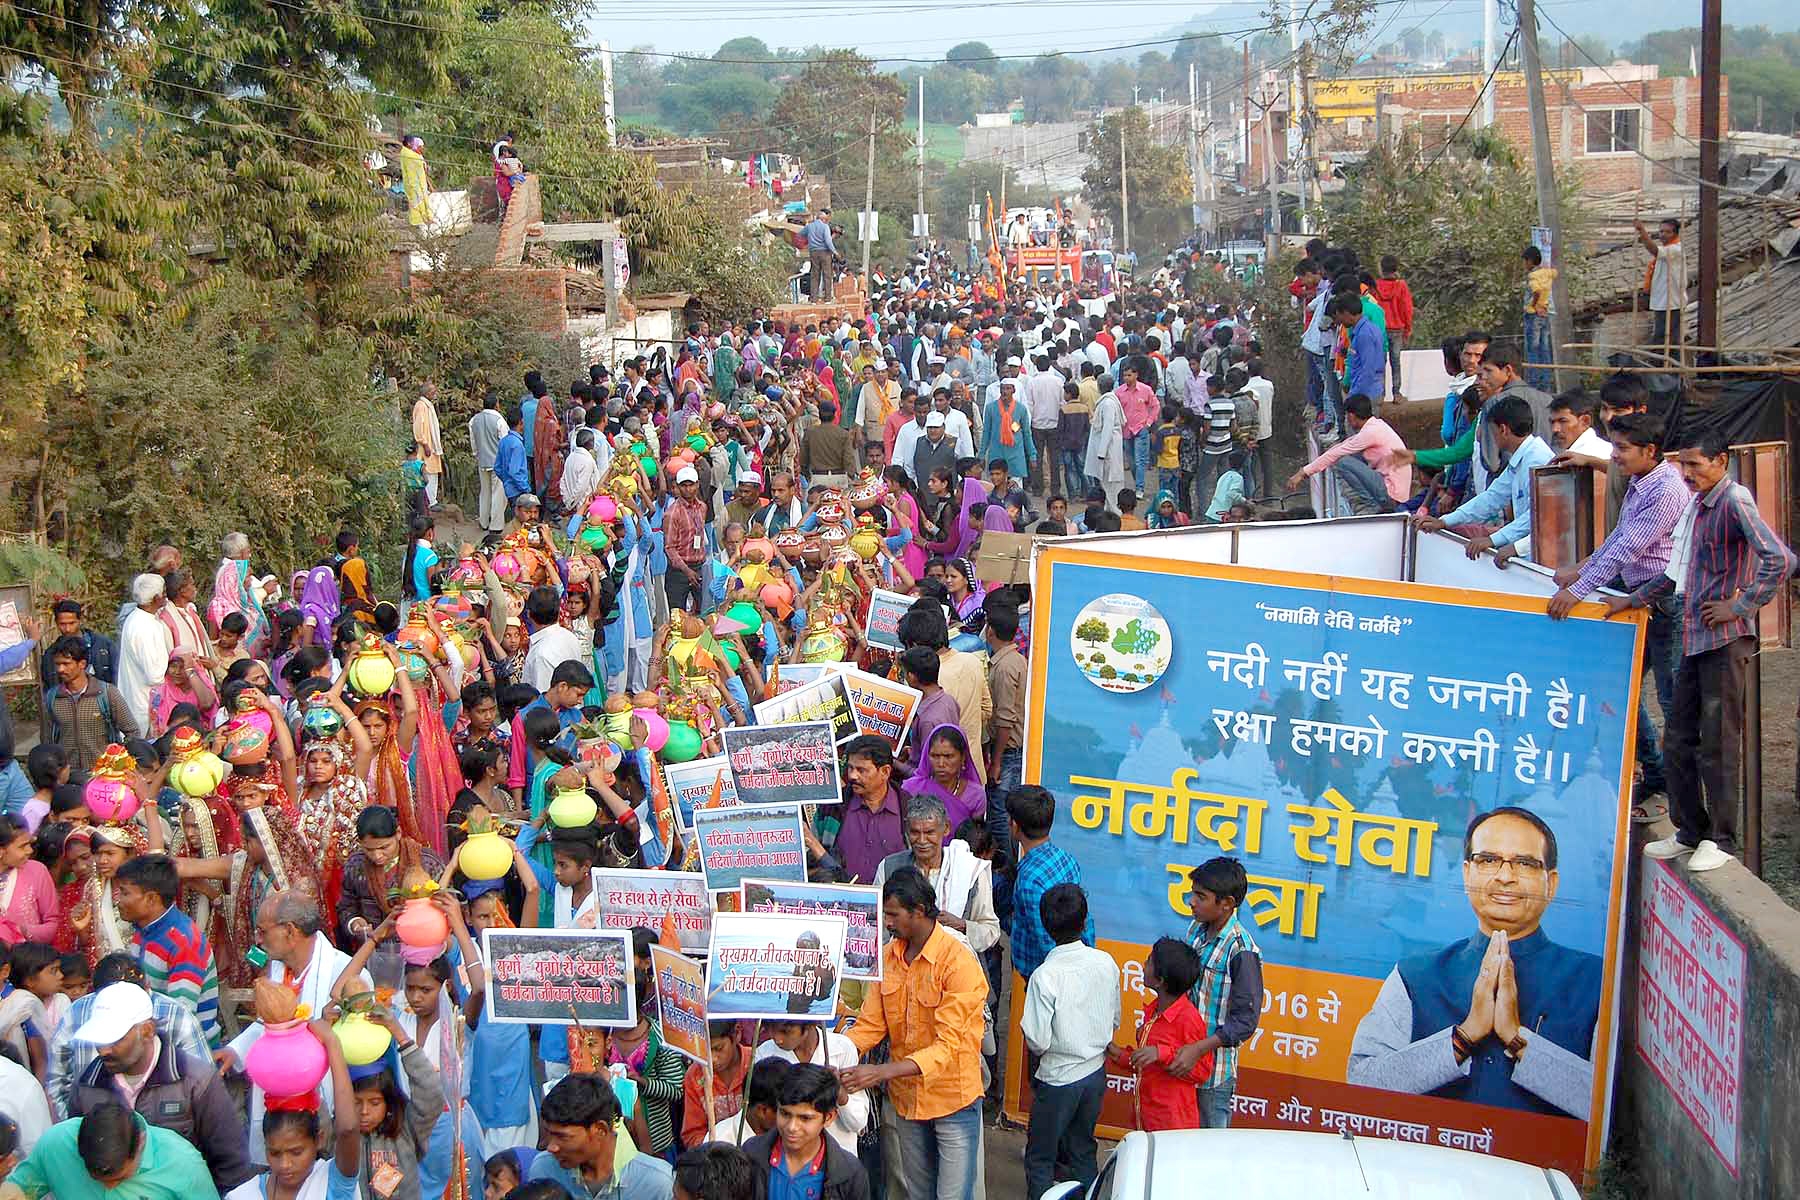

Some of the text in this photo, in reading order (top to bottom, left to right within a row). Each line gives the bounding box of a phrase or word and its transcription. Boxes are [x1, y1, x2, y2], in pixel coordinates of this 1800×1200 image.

[1324, 609, 1354, 630] देवि
[1206, 642, 1270, 688] नदी
[1283, 651, 1348, 700] नहीं
[1360, 668, 1414, 709] यह
[1427, 671, 1532, 718] जननी
[1212, 708, 1277, 745] रक्षा
[1290, 714, 1388, 758] हमको
[1402, 728, 1500, 773] करनी
[732, 745, 752, 772] युगों
[783, 742, 794, 763] से
[795, 741, 817, 763] देखा
[739, 769, 765, 789] नर्मदा
[765, 767, 794, 788] जीवन
[794, 765, 816, 785] रेखा
[1069, 767, 1438, 877] नर्मदा सेवा
[733, 832, 744, 846] का
[745, 826, 756, 847] हो
[734, 849, 757, 868] जीवन
[757, 853, 770, 867] का
[609, 891, 623, 905] हर
[625, 891, 645, 906] हाथ
[647, 887, 658, 906] से
[660, 888, 673, 907] हो
[605, 912, 633, 928] स्वच्छ
[636, 911, 650, 928] रहे
[495, 952, 521, 981] युगों
[535, 952, 560, 982] युगों
[562, 953, 575, 977] से
[577, 953, 606, 977] देखा
[719, 947, 758, 970] सुखमय
[760, 942, 792, 964] जीवन
[793, 948, 821, 967] पाना
[501, 980, 535, 1002] नर्मदा
[537, 980, 573, 1004] जीवन
[573, 980, 602, 1003] रेखा
[724, 969, 737, 992] तो
[739, 969, 769, 993] नर्मदा
[1262, 987, 1342, 1024] 016 से
[1273, 1031, 1320, 1060] तक
[1276, 1095, 1312, 1124] और
[1438, 1127, 1493, 1153] बनायें
